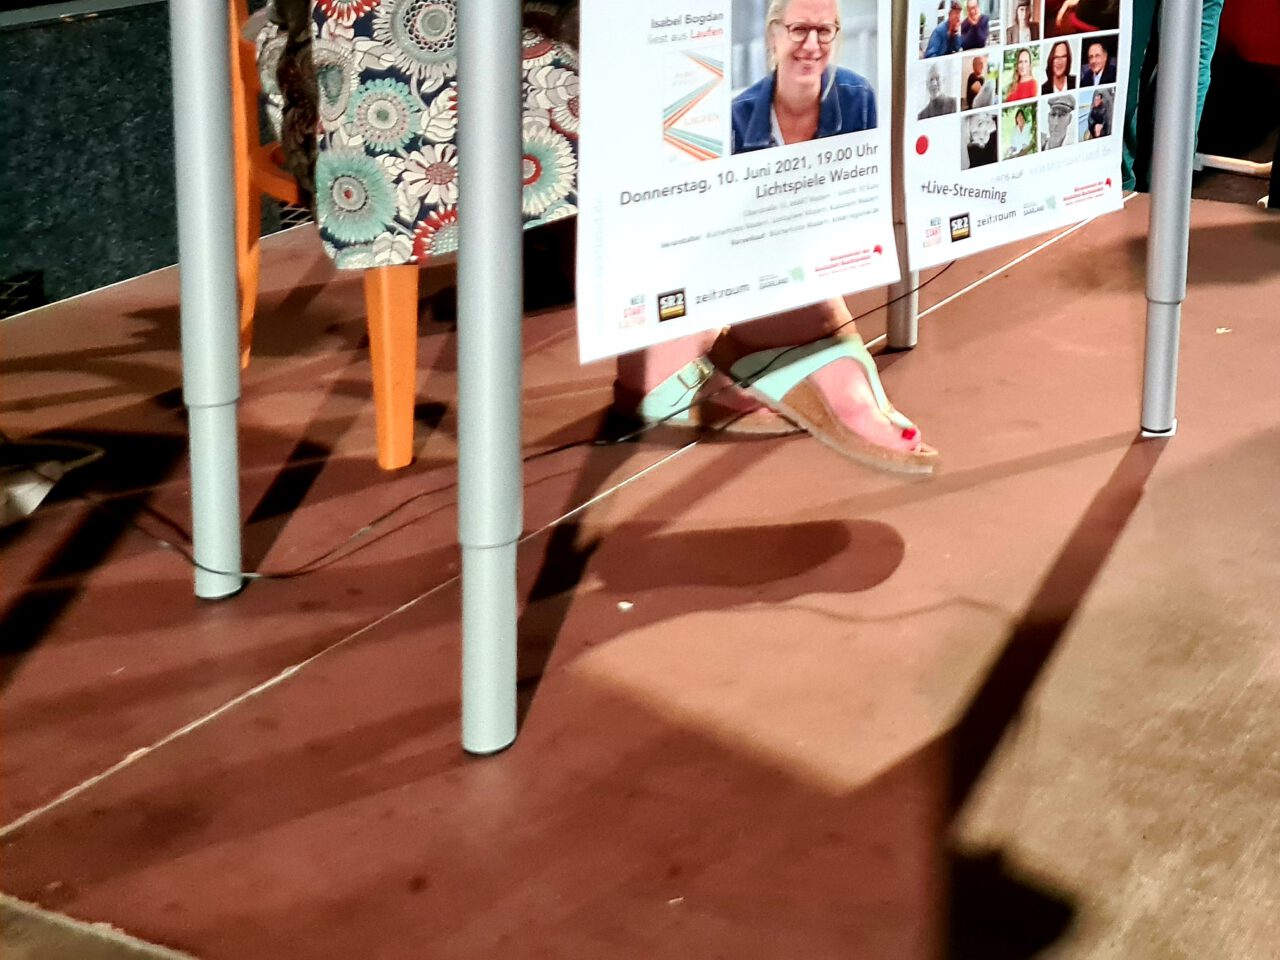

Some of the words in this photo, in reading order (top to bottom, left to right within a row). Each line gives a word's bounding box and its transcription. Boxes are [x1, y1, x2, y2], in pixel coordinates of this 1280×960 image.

[650, 14, 682, 29] Isabel
[684, 12, 724, 26] Bogdan
[619, 178, 713, 206] Donnerstag,
[717, 170, 738, 187] 10.
[743, 164, 772, 182] Juni
[774, 156, 813, 176] 2021,
[816, 147, 853, 167] 19.00
[856, 143, 879, 158] Uhr
[756, 174, 827, 200] Lichtspiele
[829, 162, 879, 184] Wadern
[920, 180, 1008, 204] +Live-Streaming
